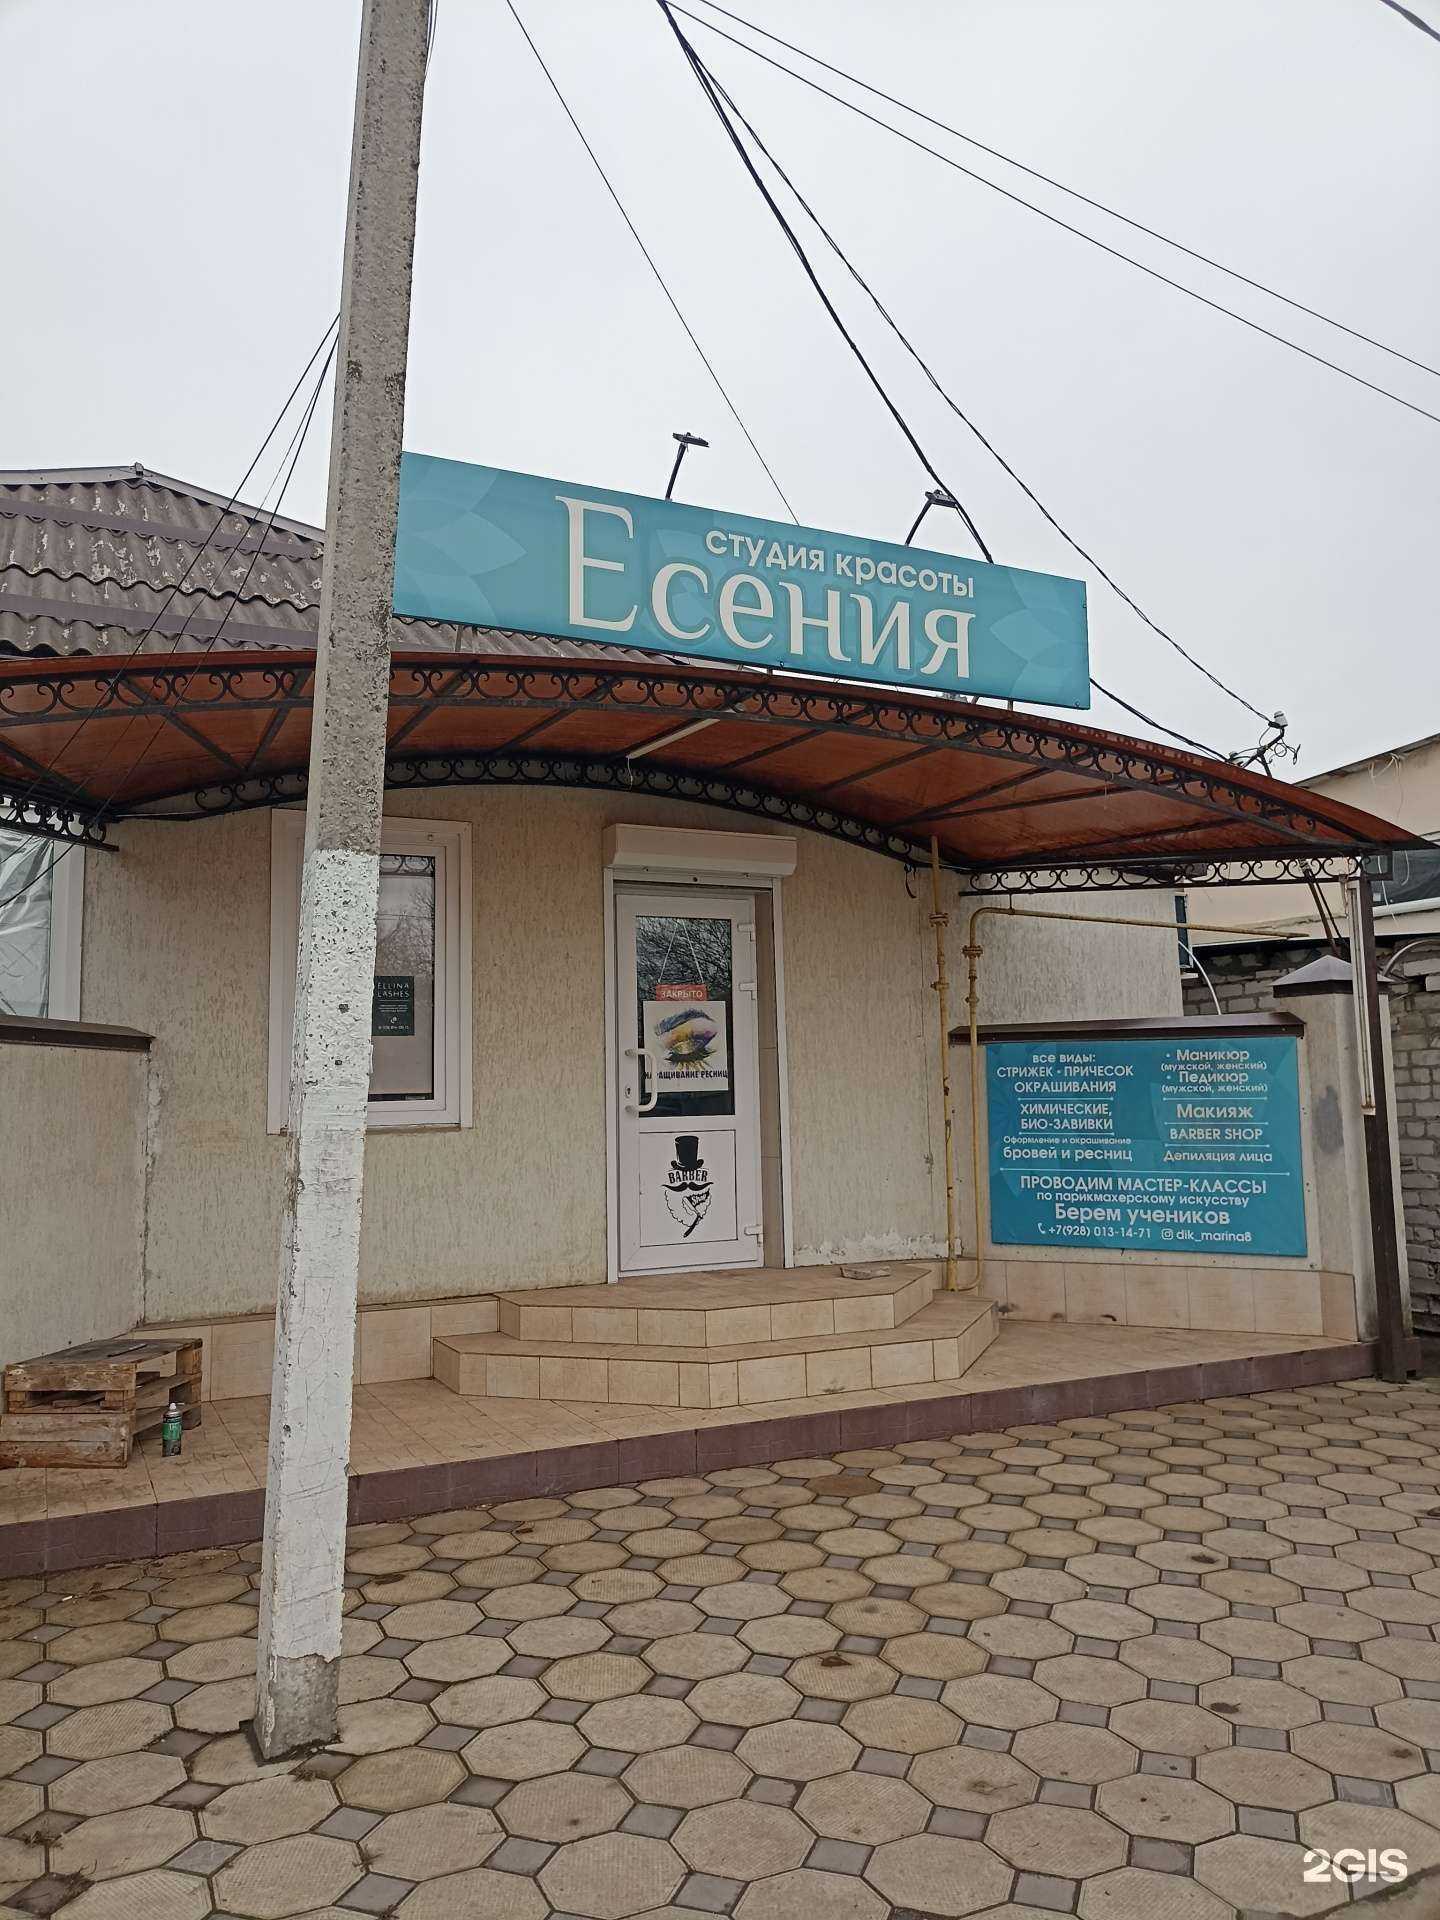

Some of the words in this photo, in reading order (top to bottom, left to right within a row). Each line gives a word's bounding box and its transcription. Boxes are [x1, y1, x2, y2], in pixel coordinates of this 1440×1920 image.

[706, 528, 825, 573] студия
[834, 552, 975, 599] красоты
[555, 494, 977, 679] Есения
[661, 990, 703, 999] ЗАКРЫТО
[1032, 1054, 1056, 1064] все
[1060, 1054, 1096, 1065] виды:
[1176, 1049, 1250, 1062] Маникюр
[997, 1066, 1054, 1078] СТРИЖЕК
[1064, 1065, 1134, 1077] ПРИЧЕСОК
[1161, 1062, 1214, 1072] (мужской,
[1217, 1061, 1267, 1071] женский)
[644, 1070, 699, 1080] НАЩИВАНИЕ
[701, 1070, 729, 1079] РЕСНИЦ
[1179, 1071, 1249, 1085] Педикюр
[1014, 1081, 1117, 1093] ОКРАШИВАНИЯ
[1162, 1084, 1214, 1094] (мужской,
[1217, 1083, 1268, 1092] женский)
[1020, 1103, 1113, 1117] ХИМИЧЕСКИЕ,
[1176, 1103, 1254, 1118] Макияж
[1021, 1118, 1113, 1130] БИО-ЗАВИВКИ
[1003, 1135, 1060, 1145] Оформление
[1069, 1137, 1132, 1145] окрашивание
[1170, 1128, 1220, 1140] BARBER
[1224, 1128, 1263, 1140] SHOP
[1003, 1147, 1057, 1160] бровей
[1061, 1149, 1070, 1159] и
[1074, 1149, 1133, 1162] ресниц
[1163, 1150, 1236, 1162] Депиляция
[1239, 1152, 1272, 1163] лица
[668, 1170, 708, 1184] BARBER
[1020, 1175, 1113, 1192] ПРОВОДИМ
[1117, 1177, 1267, 1194] МАСТЕР-КЛАССЫ
[1037, 1192, 1052, 1201] по
[1055, 1192, 1175, 1206] парикмахерскому
[1179, 1195, 1249, 1208] искусству
[1055, 1202, 1121, 1224] Берем
[1126, 1208, 1231, 1226] учеников
[1049, 1225, 1091, 1237] +7(928)
[1093, 1226, 1151, 1239] 013-14-71
